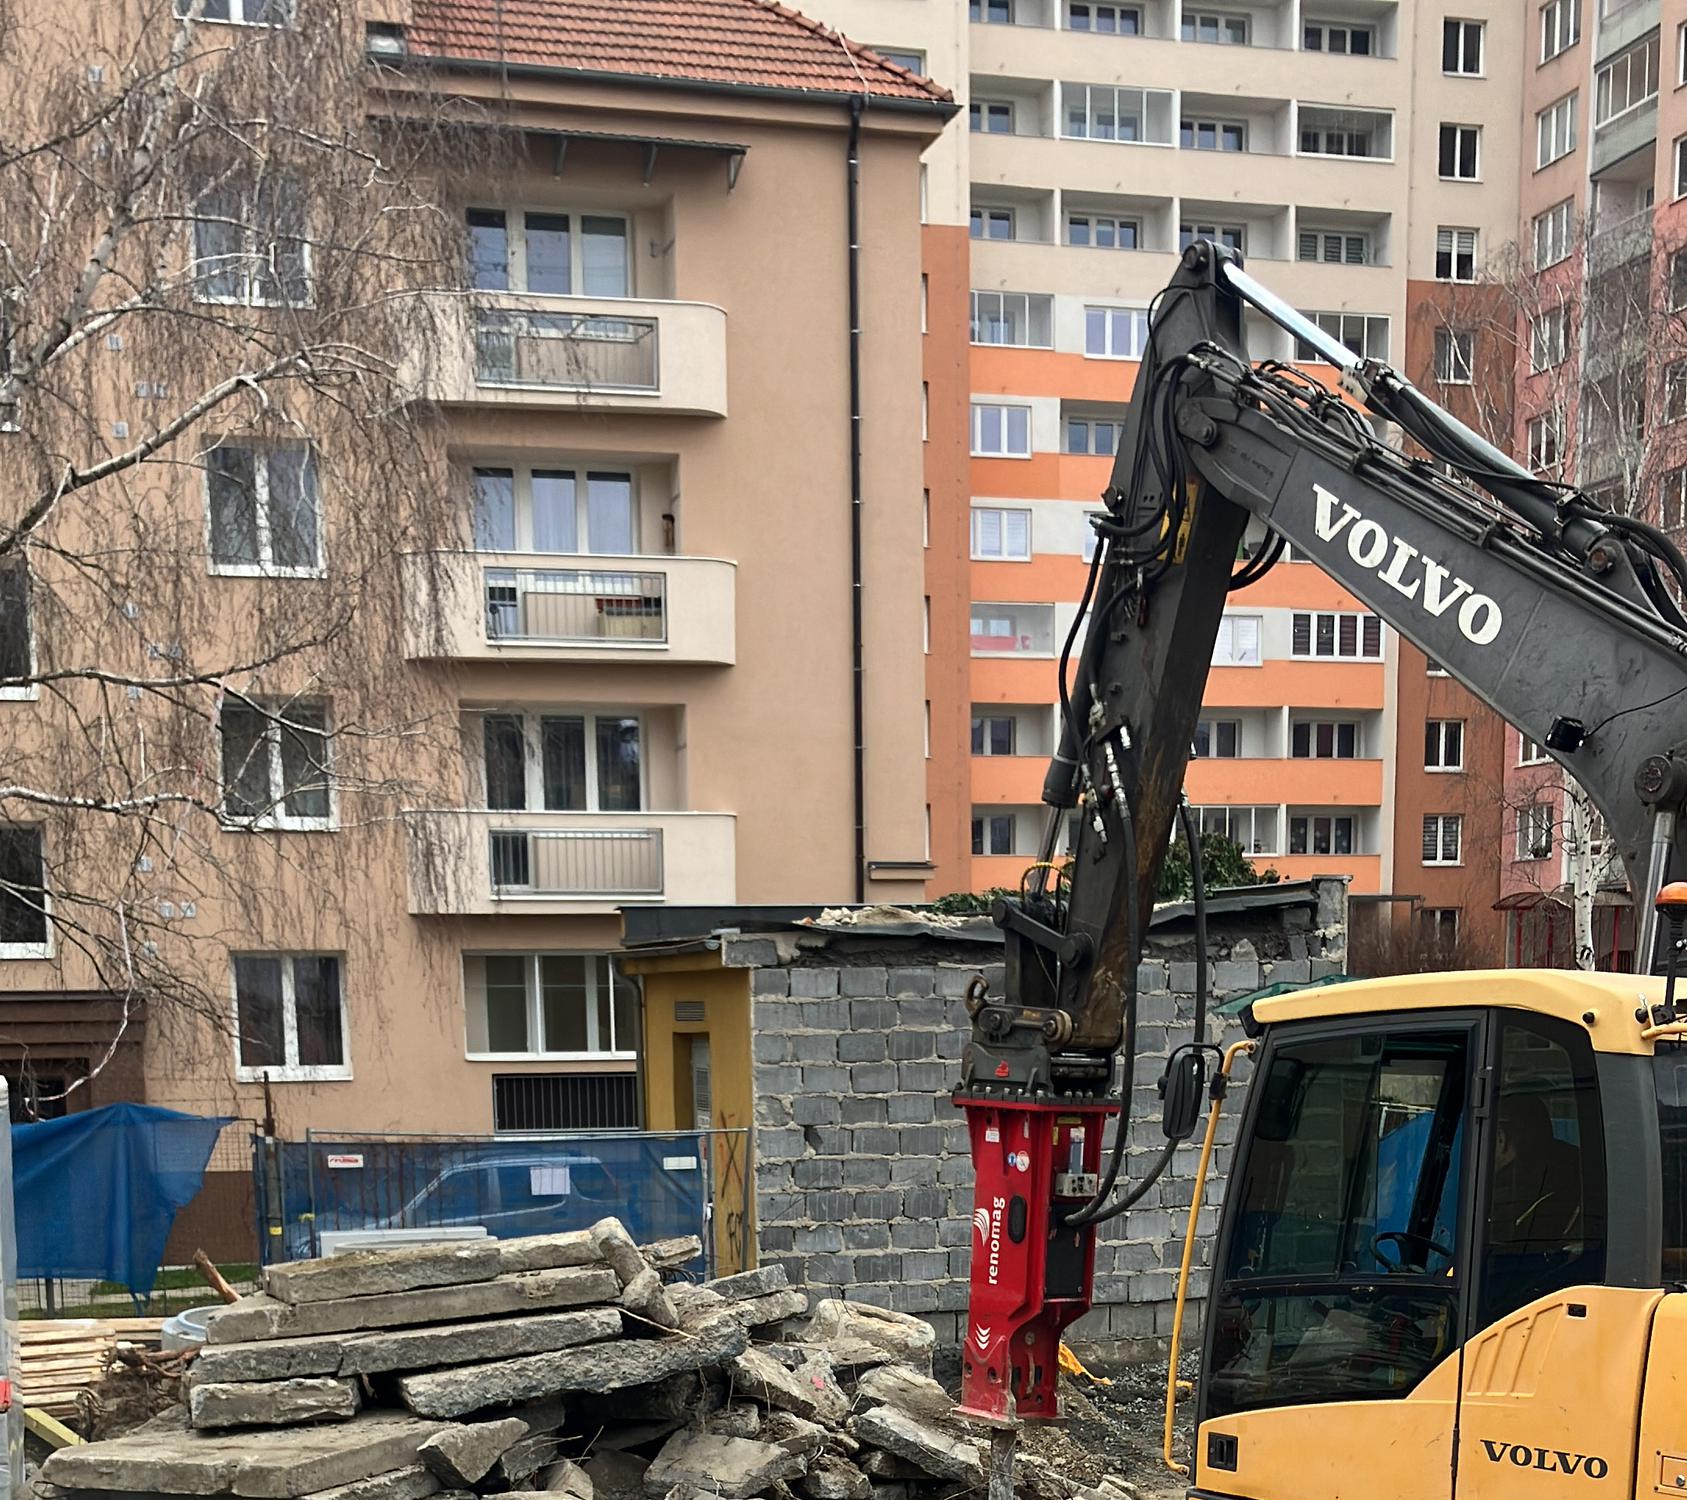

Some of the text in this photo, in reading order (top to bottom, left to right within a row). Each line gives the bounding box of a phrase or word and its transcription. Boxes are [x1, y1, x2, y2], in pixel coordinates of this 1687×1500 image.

[1312, 482, 1503, 646] VOLVO
[988, 1196, 1006, 1285] renomag
[1480, 1439, 1609, 1479] VOLVO
